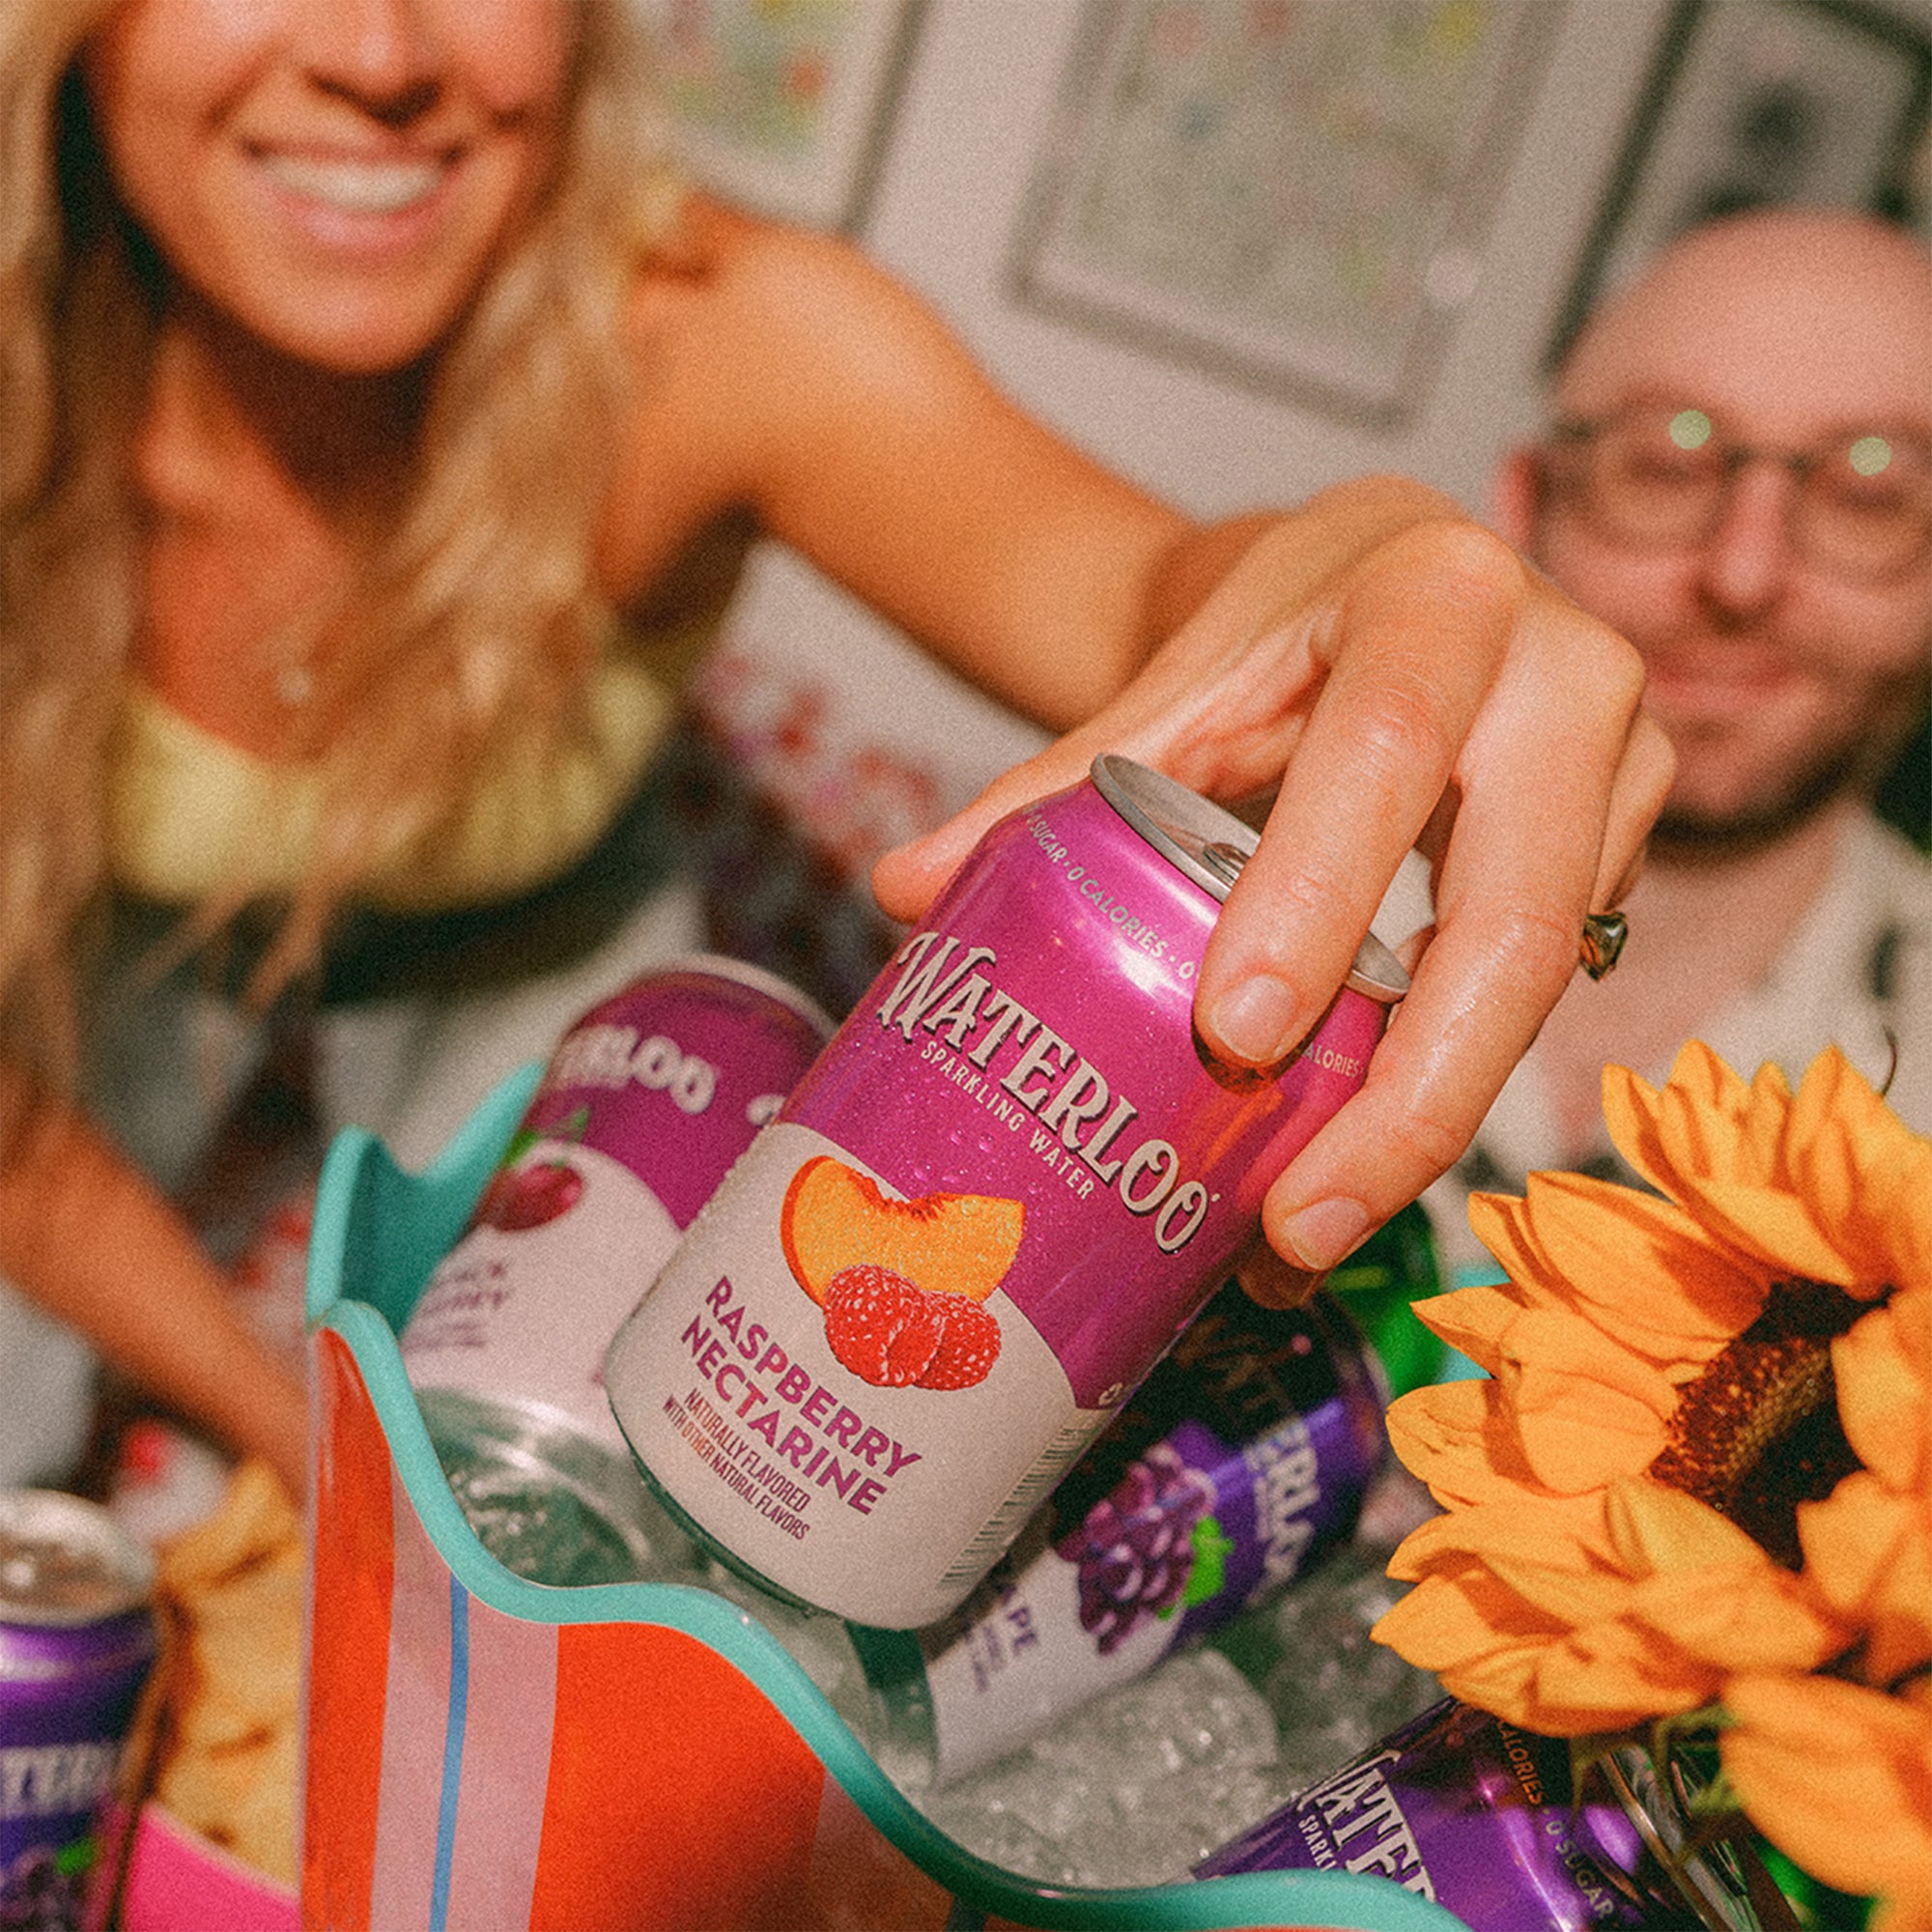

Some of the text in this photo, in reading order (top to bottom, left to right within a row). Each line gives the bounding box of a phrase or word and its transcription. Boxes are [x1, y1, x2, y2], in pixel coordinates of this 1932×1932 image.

[1029, 819, 1068, 864] SUGAR
[1079, 878, 1170, 958] CALORIES
[1299, 1042, 1360, 1078] ALORIES
[876, 930, 1209, 1255] WATERLOO
[921, 1040, 1096, 1201] SPARKLING WATER
[662, 1393, 811, 1541] WITH OTHER NATURAL FLAVORS
[680, 1315, 888, 1516] NECTARINE
[683, 1387, 811, 1514] NATURALLY FLAVORED
[704, 1274, 923, 1479] RASPBERRY
[1555, 1838, 1614, 1918] SUGAR
